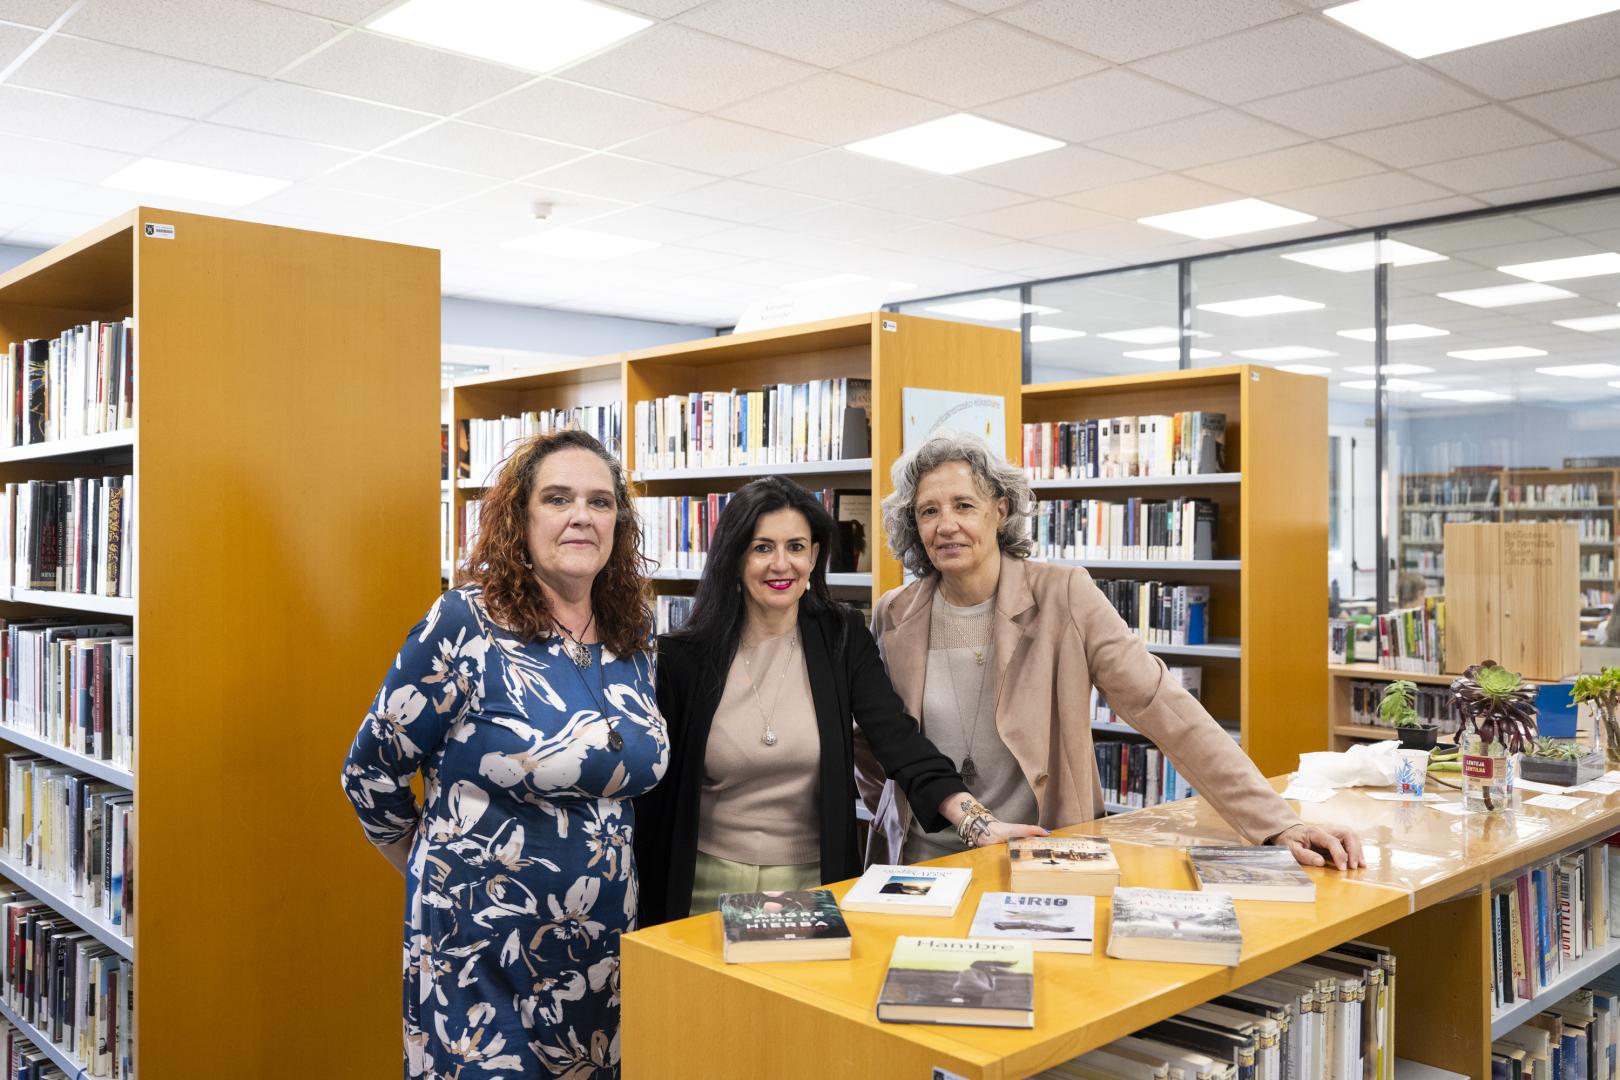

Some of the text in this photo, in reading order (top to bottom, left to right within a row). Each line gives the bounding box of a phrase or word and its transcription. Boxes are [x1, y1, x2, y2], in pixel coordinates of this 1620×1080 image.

[1004, 896, 1068, 906] LIRIO
[742, 911, 825, 920] SANGRE
[746, 920, 829, 929] HIERBA
[917, 940, 1015, 950] Hambre
